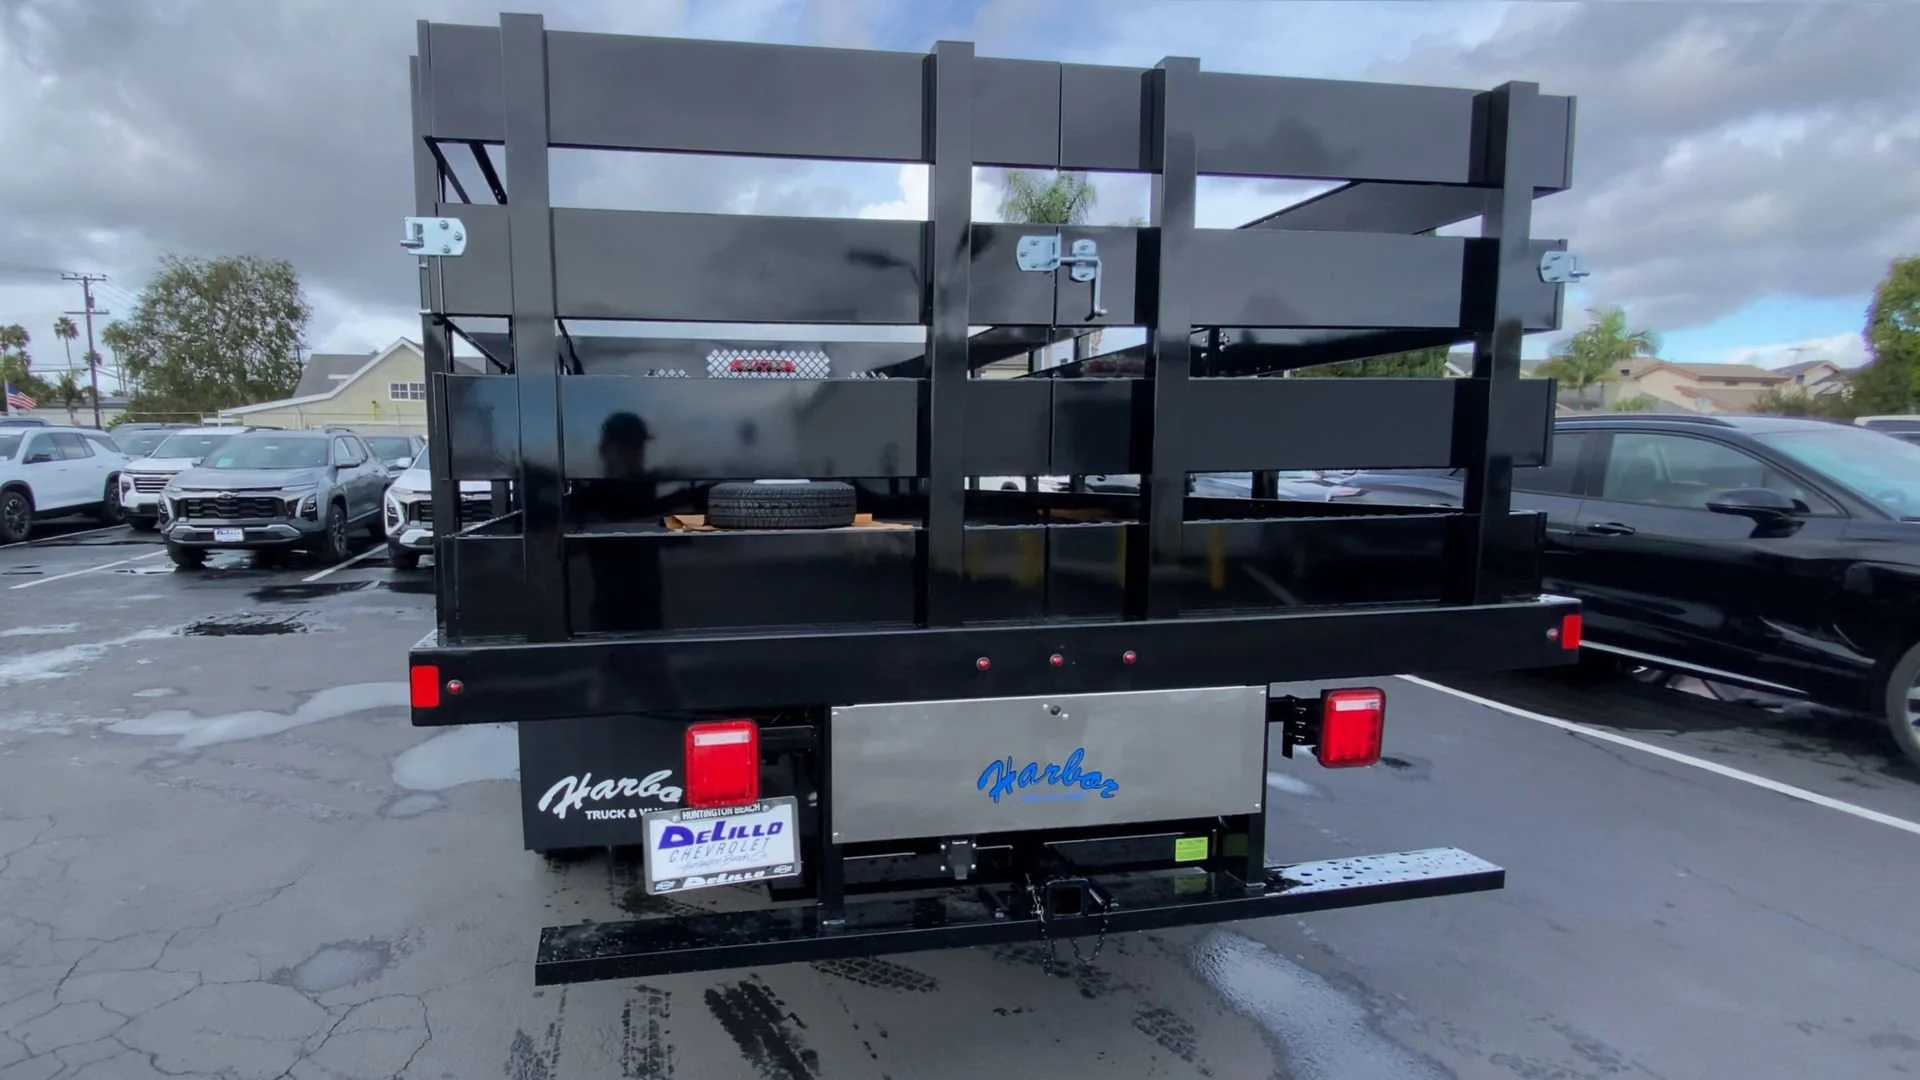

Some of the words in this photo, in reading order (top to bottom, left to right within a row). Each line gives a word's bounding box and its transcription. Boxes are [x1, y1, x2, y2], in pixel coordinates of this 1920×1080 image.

[977, 747, 1119, 803] Harbor
[538, 769, 683, 819] Harbo
[585, 809, 626, 820] TRUCK
[628, 808, 638, 818] &
[682, 807, 735, 821] HUNTINGTON
[735, 802, 761, 816] BEACH
[669, 837, 772, 863] CHEVROLET
